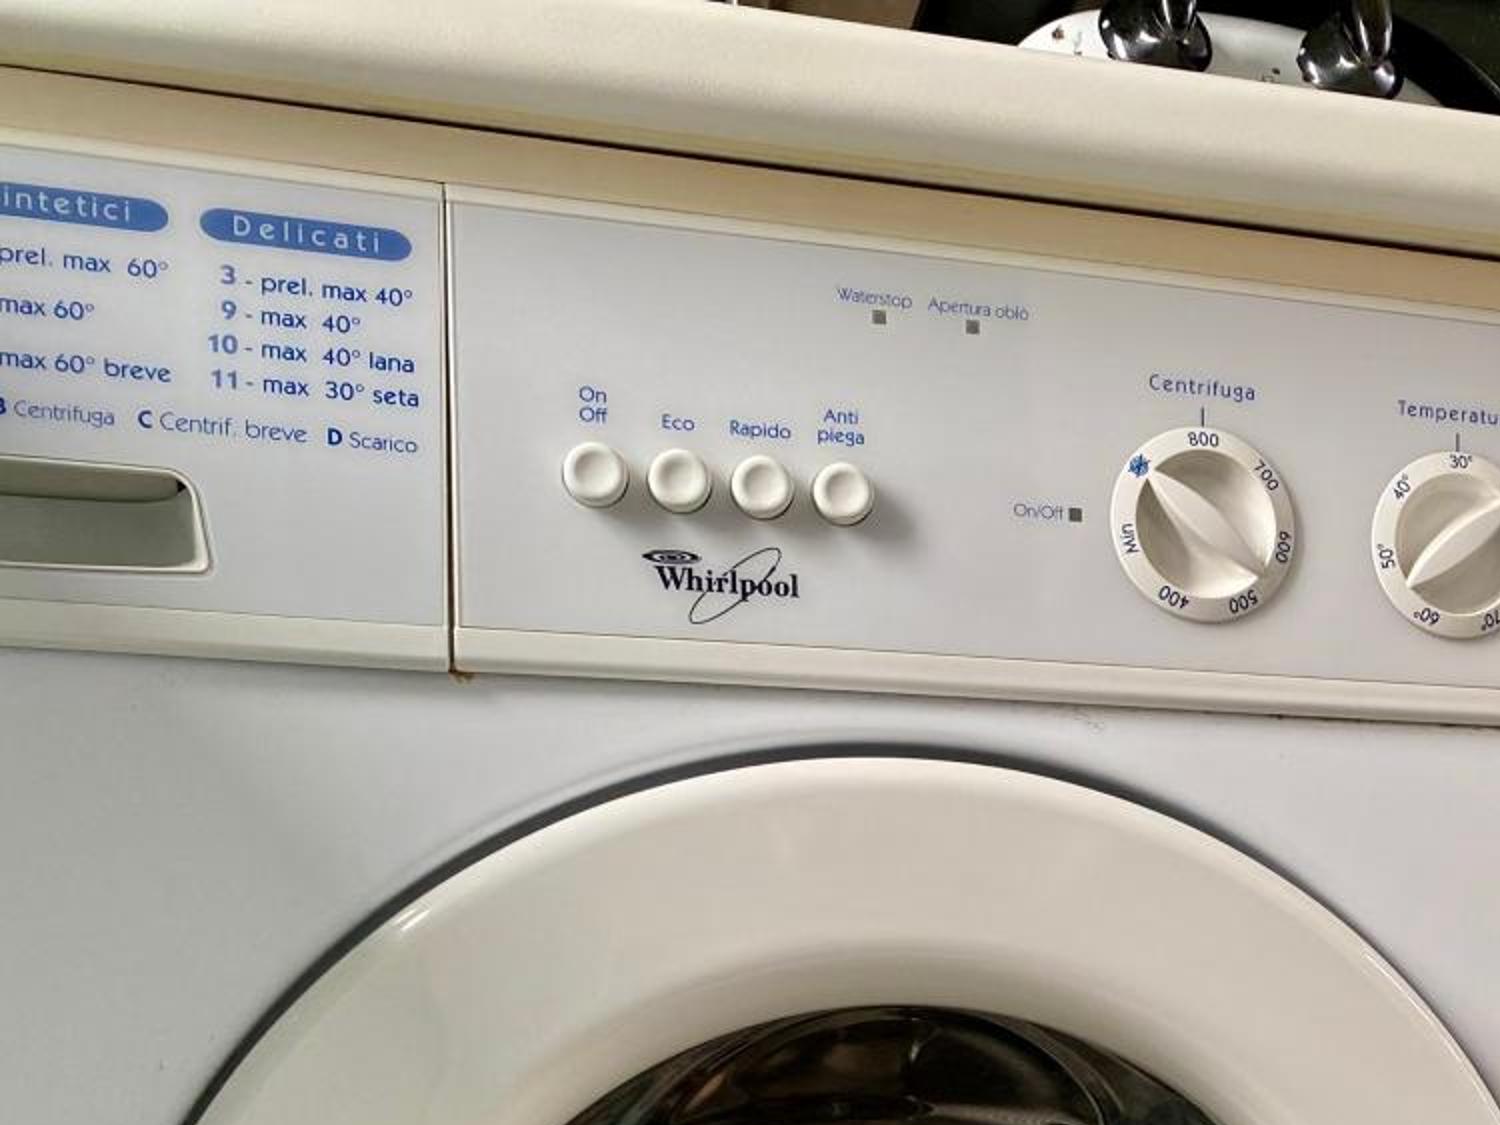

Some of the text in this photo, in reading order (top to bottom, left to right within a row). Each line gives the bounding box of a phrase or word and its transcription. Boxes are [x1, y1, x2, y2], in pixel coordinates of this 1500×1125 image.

[233, 215, 380, 253] Delicati
[63, 254, 111, 273] max
[128, 258, 168, 279] 60°
[220, 265, 236, 285] 3
[261, 277, 312, 300] prel.
[322, 284, 366, 304] max
[375, 288, 412, 307] 40°
[838, 286, 912, 310] Waterstop
[0, 298, 95, 321] max 60°
[221, 301, 236, 320] 9
[261, 310, 307, 329] max
[322, 315, 360, 334] 40°
[928, 297, 991, 319] Apertura
[208, 334, 238, 355] 10
[261, 343, 307, 363] max
[322, 348, 360, 368] 40°
[370, 352, 415, 373] lana
[0, 352, 171, 383] max 60° breve
[211, 369, 238, 390] 11
[264, 378, 309, 397] max
[325, 382, 364, 402] 30°
[373, 388, 419, 408] seta
[579, 386, 607, 404] On
[1150, 373, 1256, 402] Centrifuga
[14, 400, 115, 428] Centrifuga
[138, 411, 153, 429] C
[160, 412, 237, 437] Centrif.
[246, 419, 307, 444] breve
[327, 427, 343, 447] D
[350, 432, 418, 453] Scarico
[579, 406, 607, 424] Off
[661, 414, 695, 432] Eco
[824, 408, 858, 426] Anti
[730, 421, 791, 440] Rapido
[818, 427, 864, 447] piega
[1188, 431, 1219, 448] 800
[1254, 460, 1278, 492] 700
[1014, 502, 1064, 522] On/Off
[1123, 523, 1138, 554] Min
[1275, 531, 1291, 564] 600
[656, 563, 800, 601] Whirlpool
[1158, 585, 1189, 610] 400
[1228, 590, 1258, 614] 500
